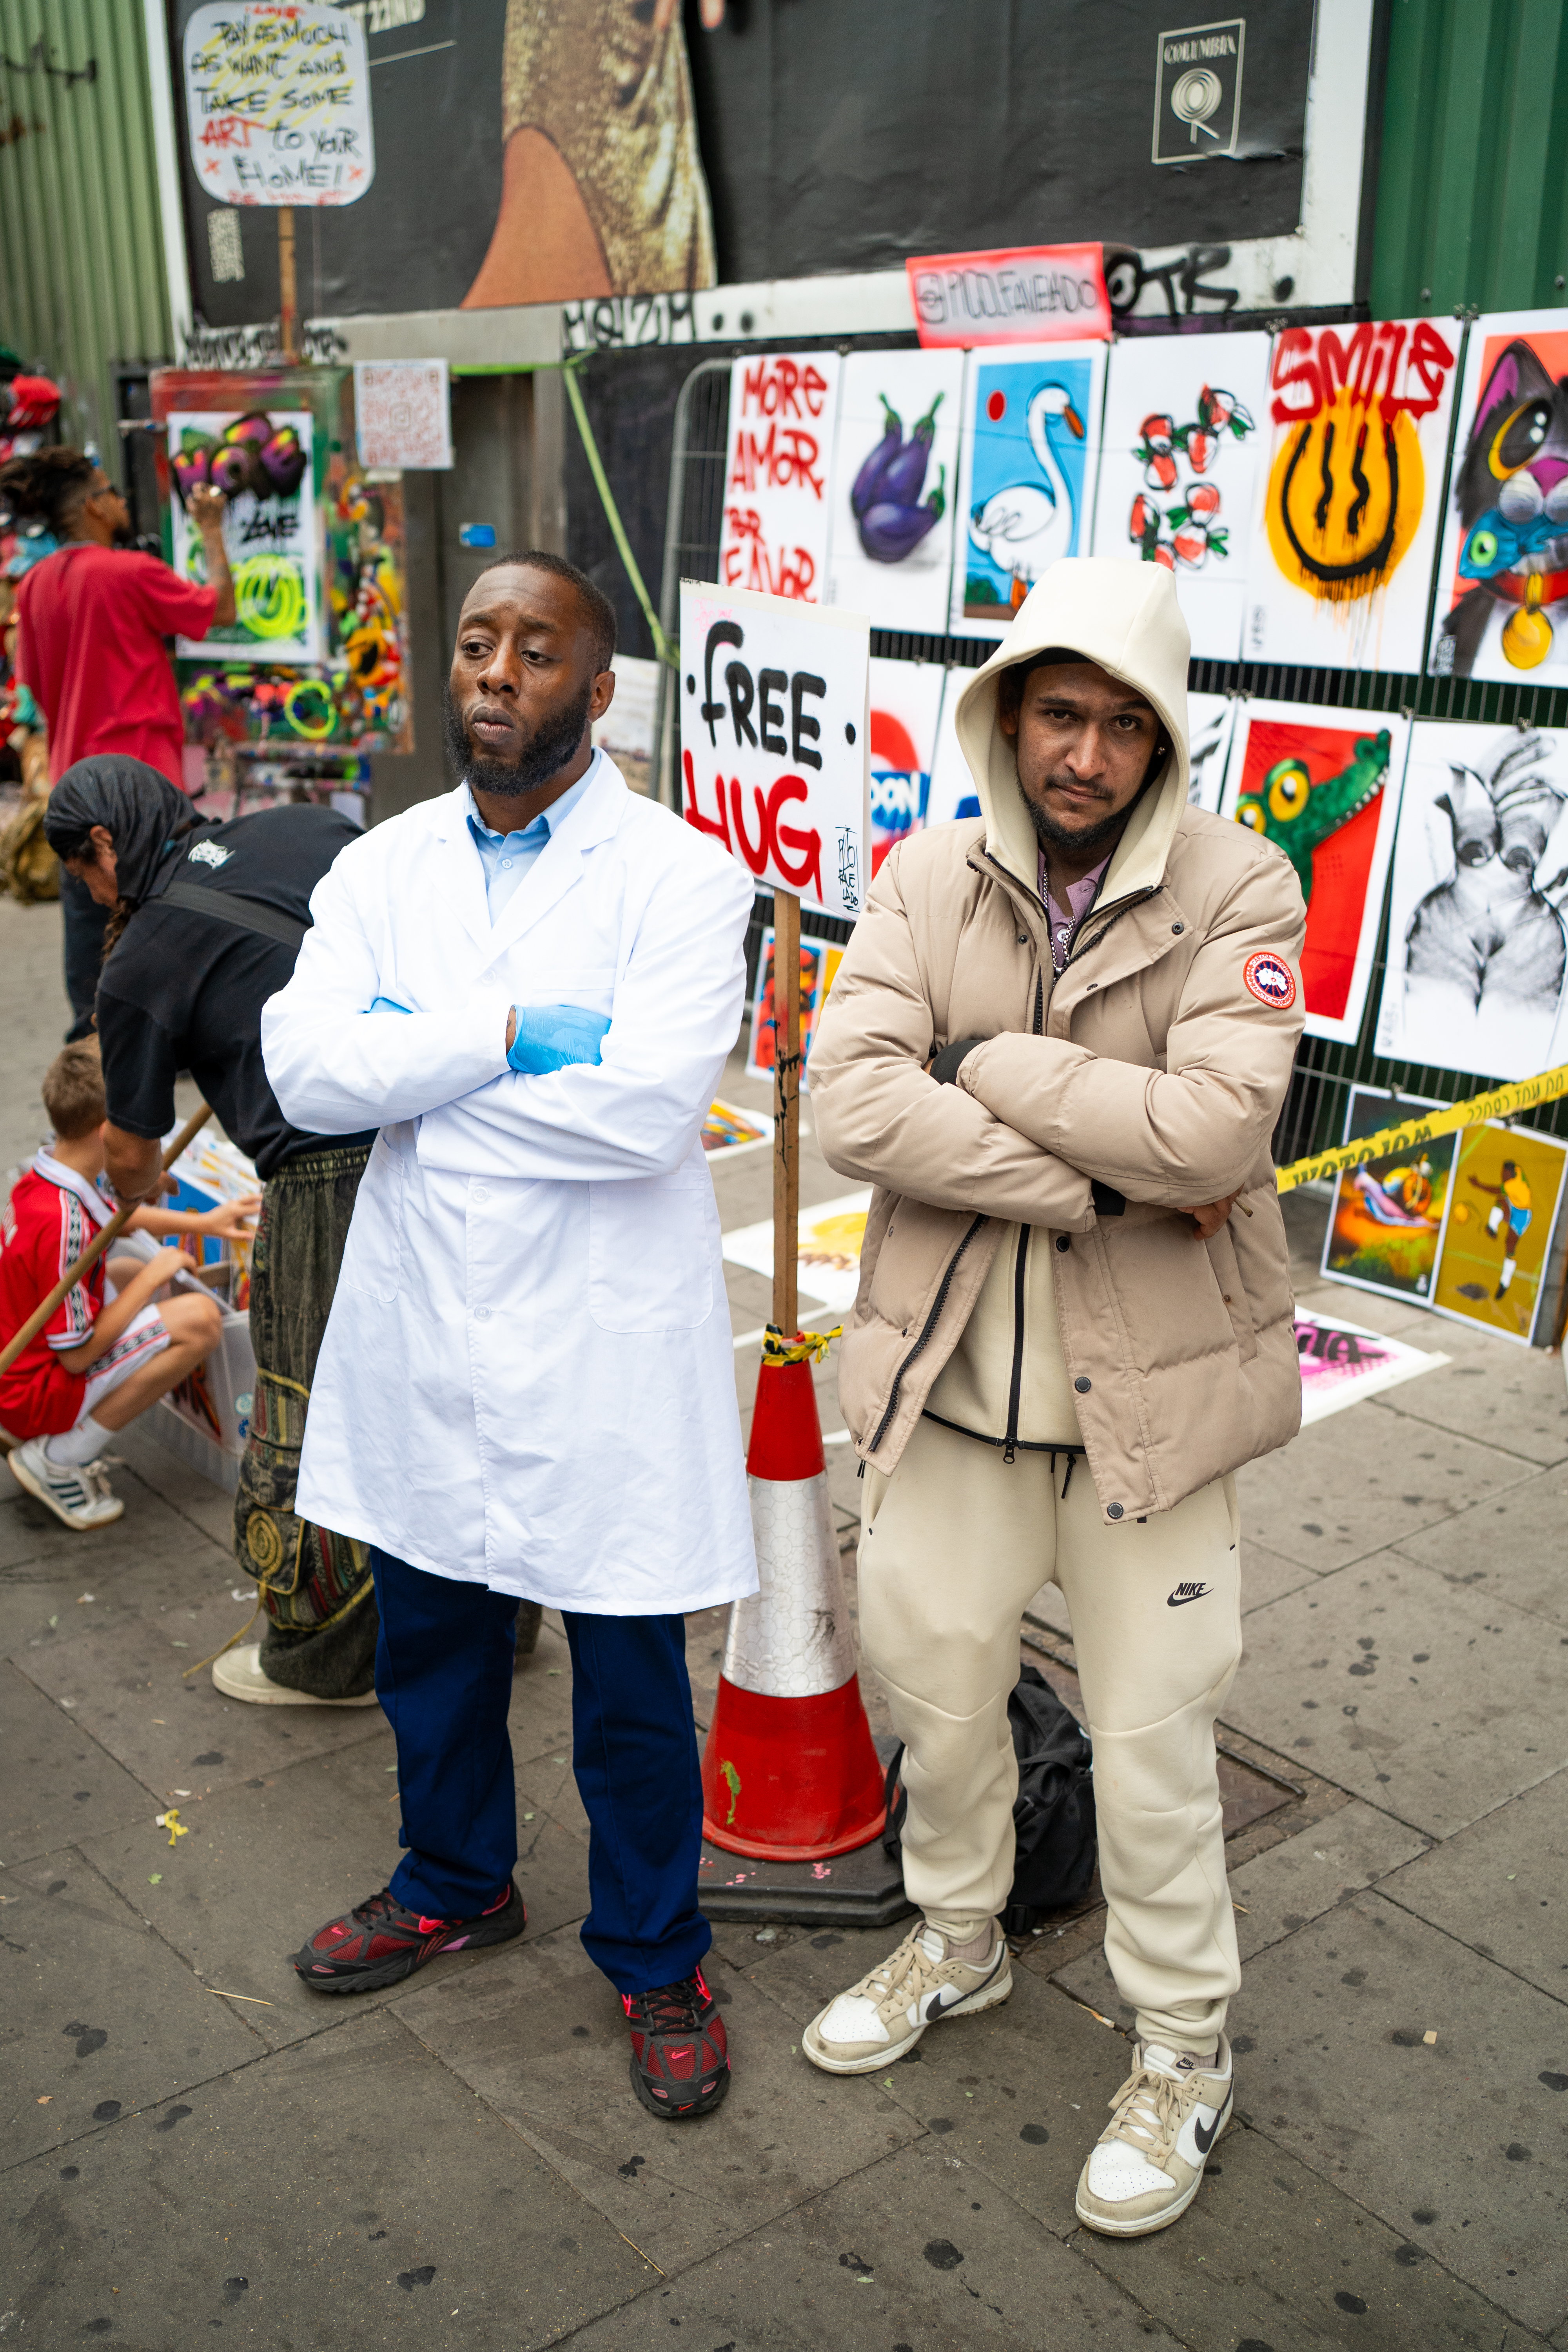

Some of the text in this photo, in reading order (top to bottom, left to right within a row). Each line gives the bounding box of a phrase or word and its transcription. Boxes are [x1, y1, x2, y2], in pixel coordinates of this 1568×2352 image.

[1164, 35, 1236, 65] COLUMBIA
[193, 86, 269, 114] TAKE
[198, 114, 265, 149] ART
[731, 420, 826, 500] AMOR
[682, 748, 824, 904] HUG
[1252, 955, 1272, 965] CANADA
[1252, 986, 1271, 1002] ARCTIC
[1175, 1583, 1206, 1595] NIKE
[1181, 2056, 1194, 2068] NIKE
